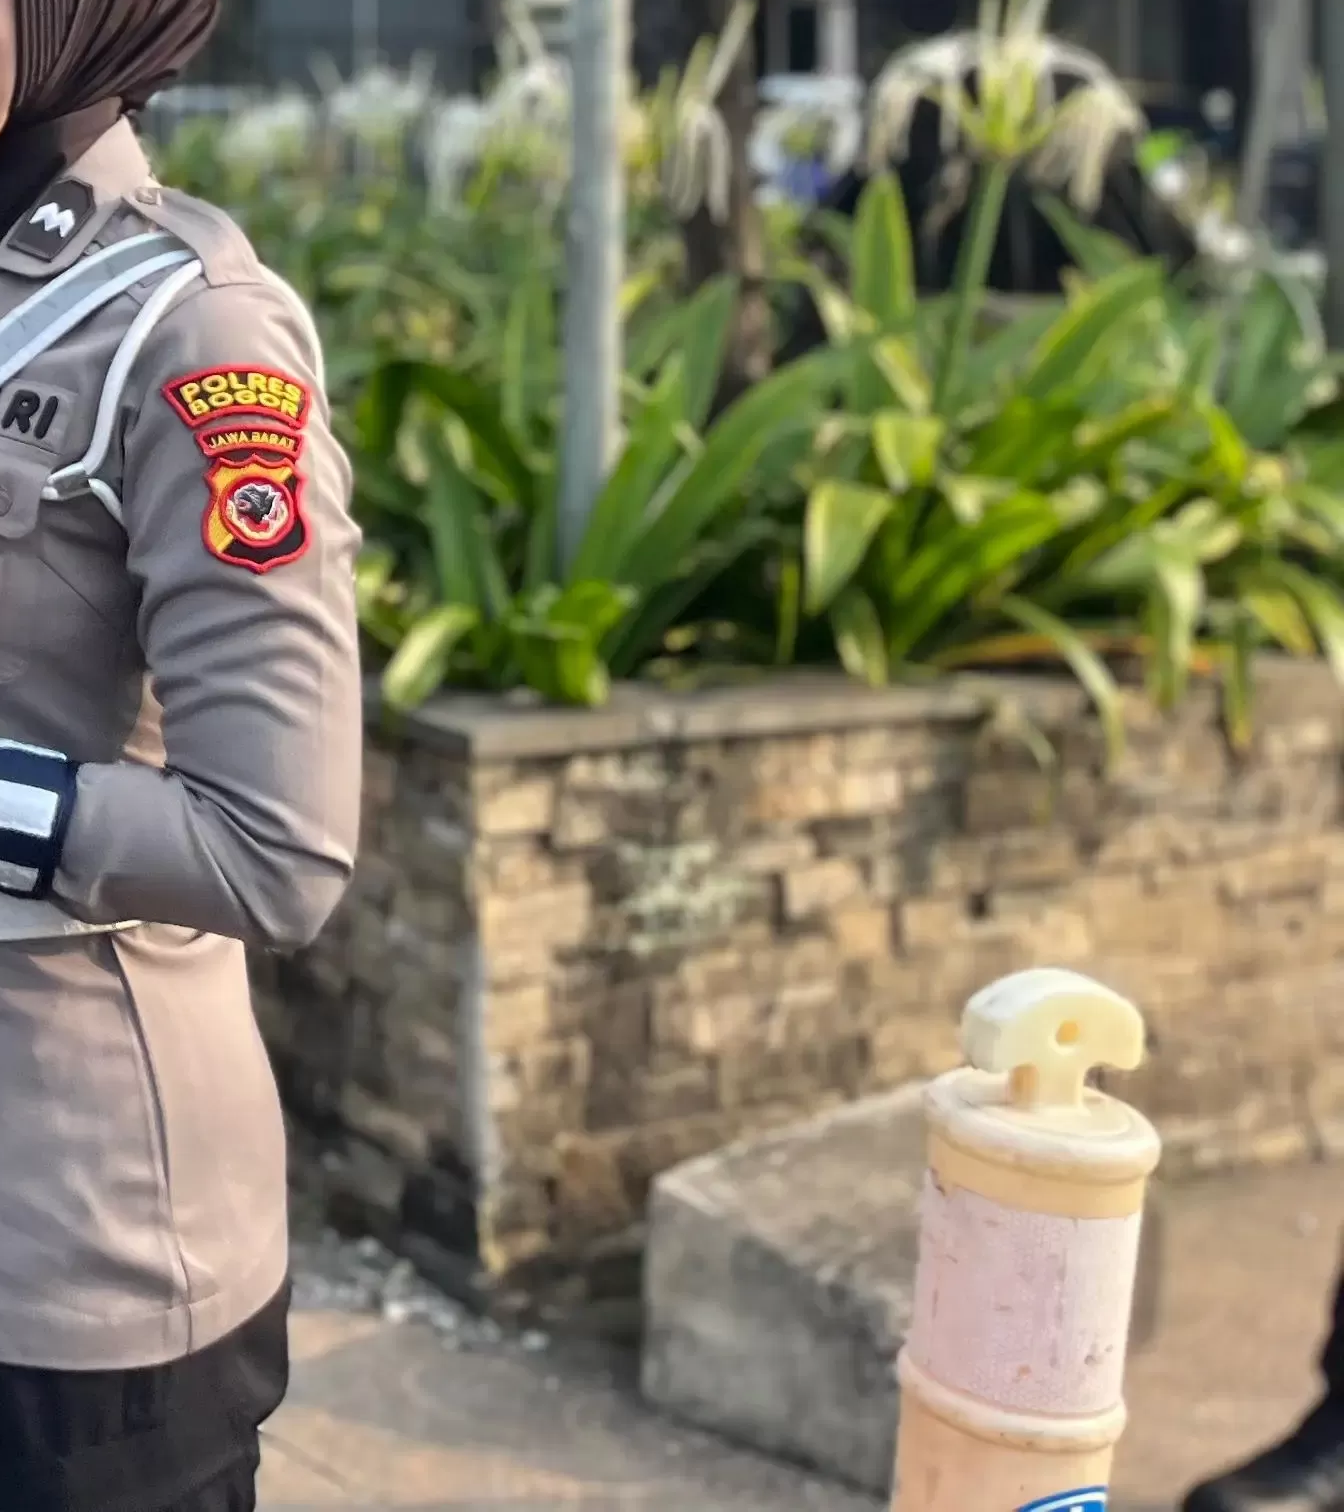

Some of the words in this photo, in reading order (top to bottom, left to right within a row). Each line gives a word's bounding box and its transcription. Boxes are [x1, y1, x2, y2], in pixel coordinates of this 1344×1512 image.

[179, 371, 302, 404] POLRES
[188, 389, 299, 419] BOGOR
[208, 431, 249, 449] JAWA
[251, 431, 296, 451] BARAT
